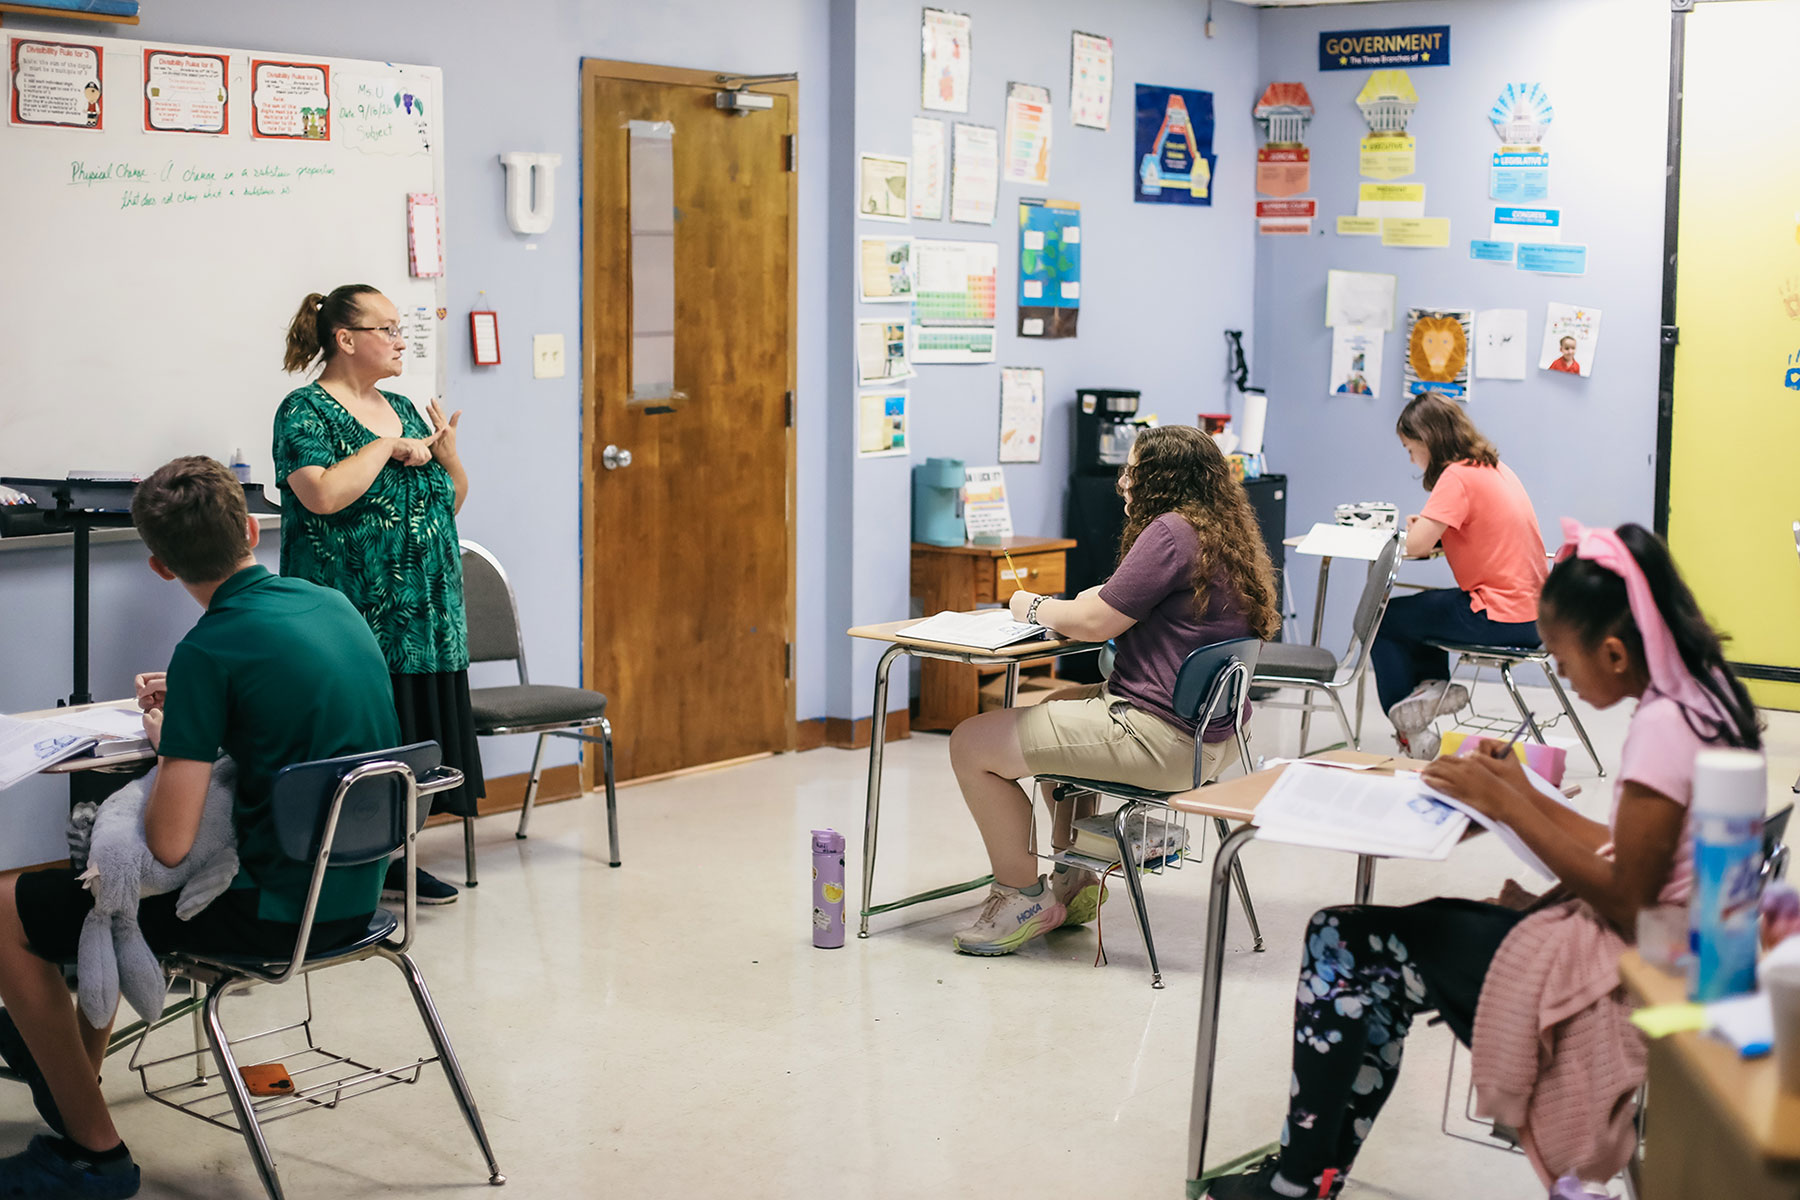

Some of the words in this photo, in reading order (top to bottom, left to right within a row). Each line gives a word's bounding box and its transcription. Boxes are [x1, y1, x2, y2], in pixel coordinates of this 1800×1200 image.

[1325, 33, 1443, 54] GOVERNMENT
[71, 160, 112, 187] Physical
[1016, 903, 1042, 924] HOKA
